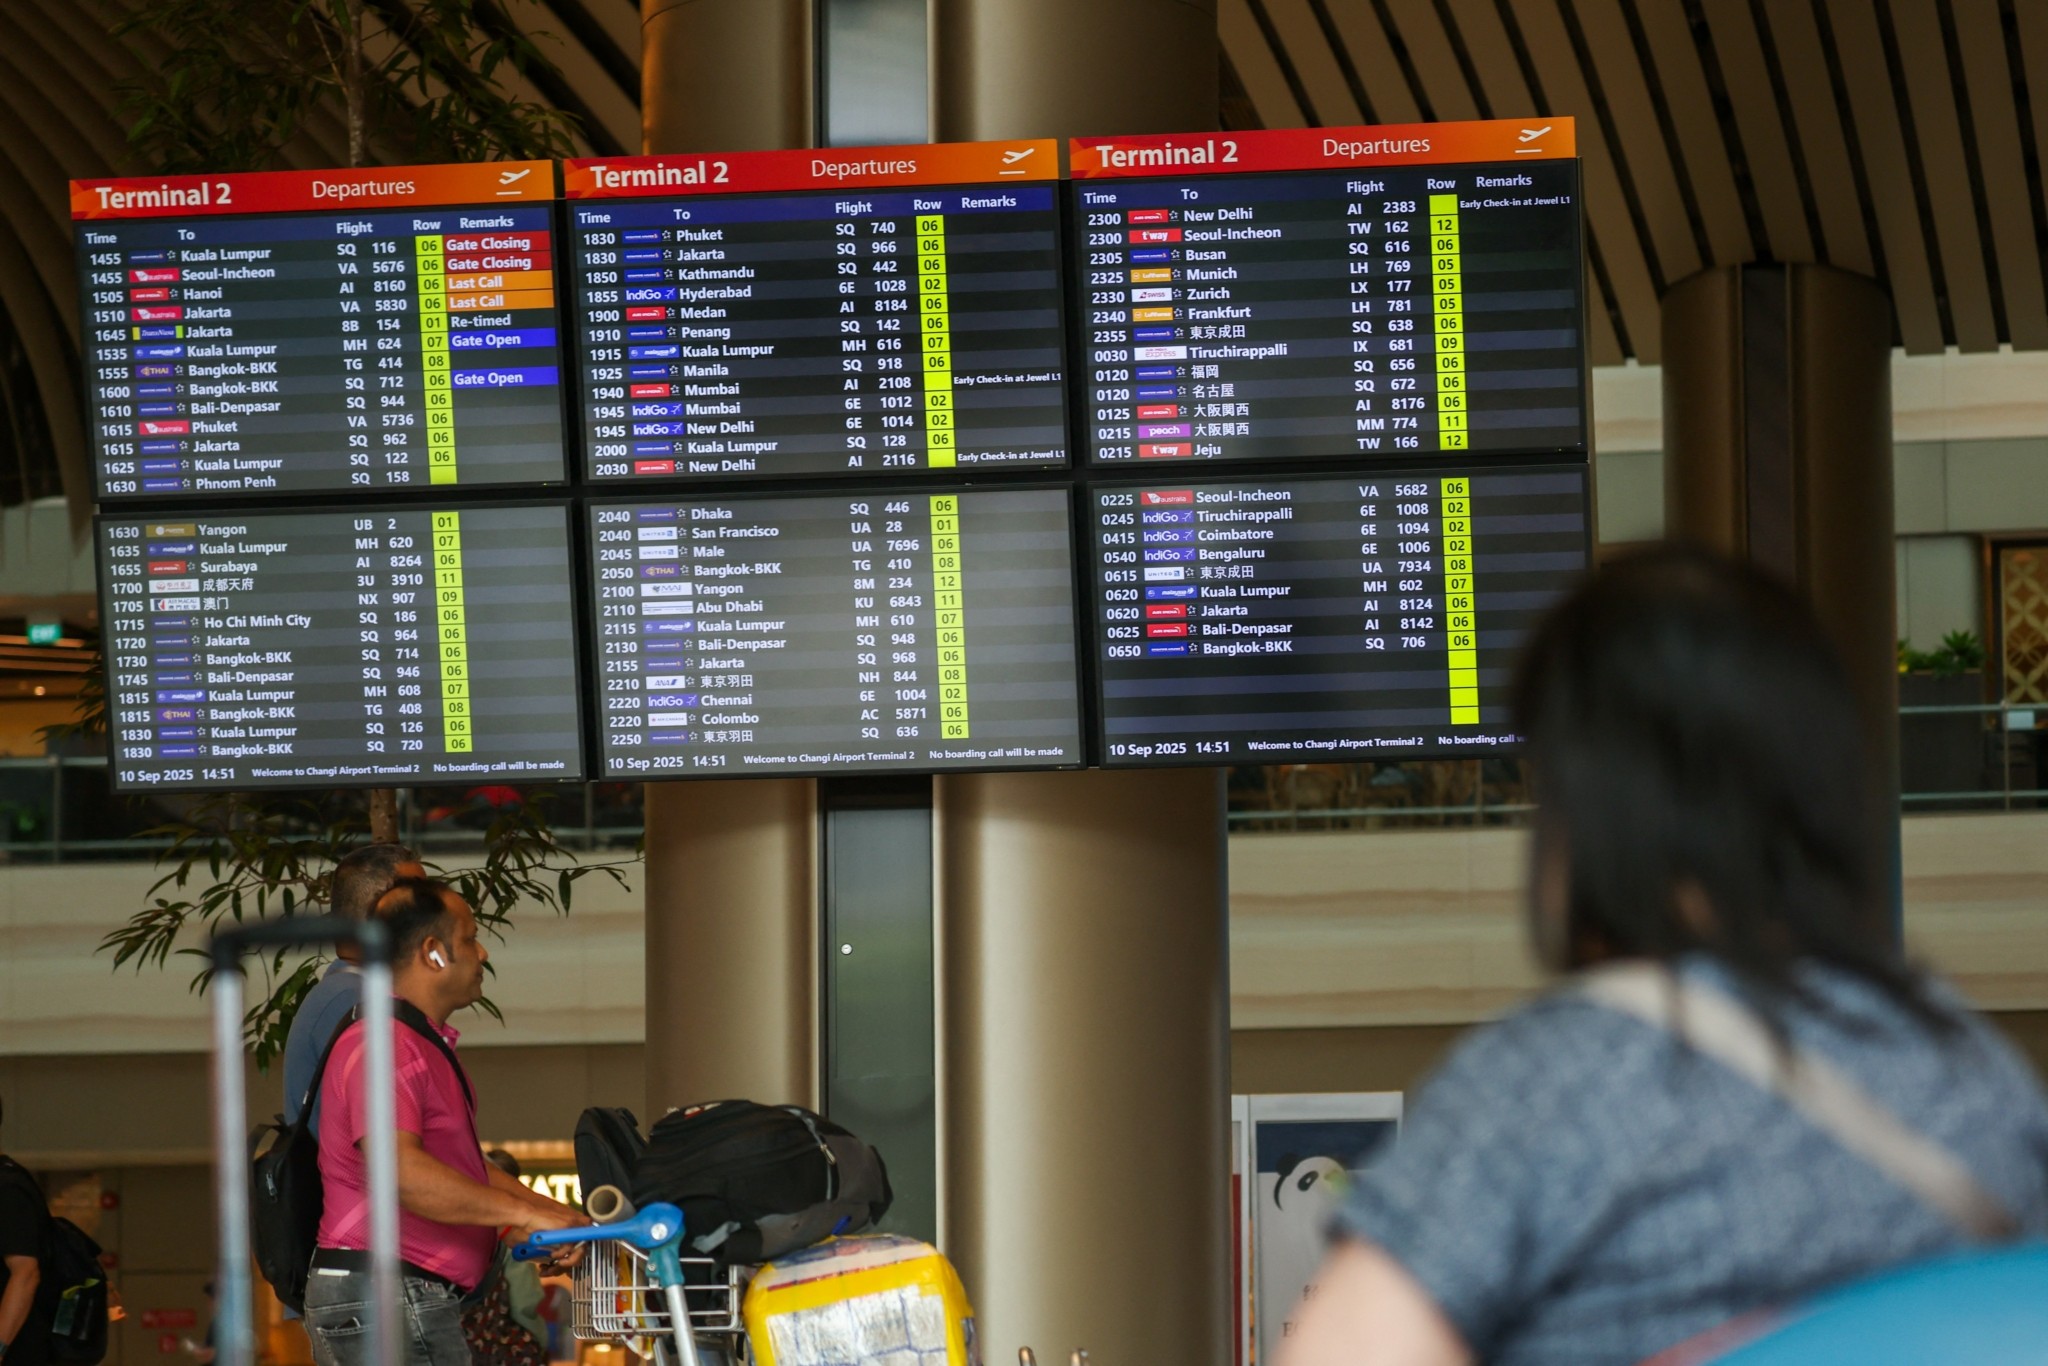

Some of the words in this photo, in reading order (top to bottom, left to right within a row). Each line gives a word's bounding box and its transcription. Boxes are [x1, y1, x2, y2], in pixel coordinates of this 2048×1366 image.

[1096, 140, 1214, 167] Terminal
[1222, 141, 1238, 162] 2
[1323, 138, 1430, 159] Departures
[590, 160, 706, 188] Terminal
[713, 161, 729, 183] 2
[812, 160, 916, 180] Departures
[95, 182, 209, 209] Terminal
[216, 183, 232, 204] 2
[312, 181, 415, 201] Departures
[1084, 192, 1117, 204] Time
[1181, 189, 1198, 200] To
[1347, 180, 1384, 195] Flight
[1427, 178, 1456, 189] Row
[1476, 174, 1532, 187] Remarks
[85, 232, 117, 244] Time
[178, 229, 195, 240] To
[336, 221, 373, 236] Flight
[413, 219, 441, 230] Row
[460, 215, 514, 228] Remarks
[584, 233, 615, 245] 1830
[677, 229, 723, 242] Phuket
[836, 223, 855, 236] SQ
[871, 222, 895, 234] 740
[922, 220, 938, 232] 06
[1089, 233, 1122, 245] 2300
[1184, 227, 1281, 241] Seoul-Incheon
[1347, 222, 1371, 234] TW
[1385, 221, 1409, 233] 162
[1437, 219, 1452, 230] 12
[90, 253, 121, 265] 1455
[181, 249, 217, 262] Kuala
[220, 248, 271, 262] Lumpur
[337, 243, 356, 256] SQ
[372, 242, 396, 254] 116
[421, 240, 437, 251] 06
[446, 239, 478, 251] Gate
[481, 237, 530, 251] Closing
[587, 291, 618, 303] 1855
[626, 289, 662, 300] IndiGo
[680, 285, 751, 302] Hyderabad
[839, 282, 855, 293] 6E
[875, 280, 906, 292] 1028
[925, 278, 940, 290] 02
[94, 310, 125, 322] 1510
[184, 307, 231, 319] Jakarta
[340, 301, 360, 313] VA
[375, 299, 407, 311] 5830
[425, 298, 441, 309] 06
[450, 297, 477, 308] Last
[479, 295, 504, 307] Call
[95, 329, 126, 341] 1645
[186, 326, 233, 338] Jakarta
[342, 320, 359, 332] 8B
[377, 319, 400, 330] 154
[426, 317, 440, 328] 01
[451, 314, 511, 328] Re-timed
[1094, 330, 1126, 342] 2355
[1190, 325, 1245, 340] 東京成田
[1352, 321, 1372, 333] SQ
[1388, 319, 1413, 331] 638
[1440, 318, 1457, 329] 06
[1095, 350, 1128, 362] 0030
[1189, 343, 1287, 360] Tiruchirappalli
[1353, 341, 1368, 352] IX
[1389, 339, 1412, 351] 681
[1441, 337, 1457, 349] 09
[99, 386, 130, 398] 1600
[190, 381, 278, 397] Bangkok-BKK
[345, 377, 364, 390] SQ
[379, 376, 404, 388] 712
[429, 374, 445, 386] 06
[454, 374, 485, 385] Gate
[488, 372, 523, 387] Open
[592, 387, 624, 399] 1940
[685, 382, 739, 396] Mumbai
[844, 379, 858, 390] AI
[879, 377, 911, 389] 2108
[954, 376, 975, 386] Early
[976, 375, 1013, 383] Check-in
[1026, 373, 1050, 382] Jewel
[1098, 427, 1131, 440] 0215
[1195, 422, 1249, 436] 大阪関西
[1357, 418, 1384, 430] MM
[1392, 417, 1418, 429] 774
[1446, 416, 1459, 427] 11
[1102, 513, 1134, 525] 0245
[1143, 512, 1179, 523] IndiGo
[1196, 507, 1292, 523] Tiruchirappalli
[1360, 505, 1376, 516] 6E
[1396, 503, 1429, 515] 1008
[1448, 502, 1463, 513] 02
[599, 530, 631, 542] 2040
[692, 527, 716, 539] San
[719, 525, 779, 538] Francisco
[851, 522, 872, 533] UA
[886, 521, 902, 532] 28
[937, 519, 951, 531] 01
[112, 582, 143, 594] 1700
[203, 577, 254, 592] 成都天府
[357, 575, 374, 586] 3U
[392, 574, 423, 586] 3910
[442, 573, 455, 583] 11
[604, 604, 635, 616] 2110
[696, 602, 722, 613] Abu
[726, 600, 763, 612] Dhabi
[855, 597, 873, 608] KU
[890, 596, 922, 607] 6843
[942, 594, 954, 605] 11
[114, 619, 145, 631] 1715
[204, 617, 223, 628] Ho
[226, 616, 246, 628] Chi
[250, 615, 283, 627] Minh
[286, 614, 311, 628] City
[359, 612, 378, 624] SQ
[394, 611, 417, 622] 186
[443, 610, 458, 621] 06
[1108, 645, 1141, 657] 0650
[1203, 640, 1292, 656] Bangkok-BKK
[1366, 638, 1385, 650] SQ
[1401, 636, 1426, 648] 706
[1454, 635, 1469, 646] 06
[609, 697, 640, 709] 2220
[648, 696, 683, 706] IndiGo
[701, 694, 752, 706] Chennai
[860, 690, 875, 701] 6E
[895, 689, 927, 700] 1004
[945, 688, 960, 699] 02
[1438, 736, 1453, 744] No
[1454, 735, 1497, 745] boarding
[1499, 734, 1514, 743] call
[120, 771, 134, 782] 10
[137, 770, 161, 784] Sep
[163, 769, 194, 781] 2025
[202, 768, 234, 779] 14:51
[252, 768, 293, 777] Welcome
[294, 768, 305, 776] to
[306, 766, 337, 777] Changi
[339, 766, 371, 776] Airport
[372, 764, 412, 773] Terminal
[414, 764, 419, 772] 2
[433, 764, 447, 772] No
[448, 763, 489, 773] boarding
[491, 762, 506, 770] call
[508, 761, 524, 770] will
[526, 761, 538, 769] be
[539, 760, 565, 769] made
